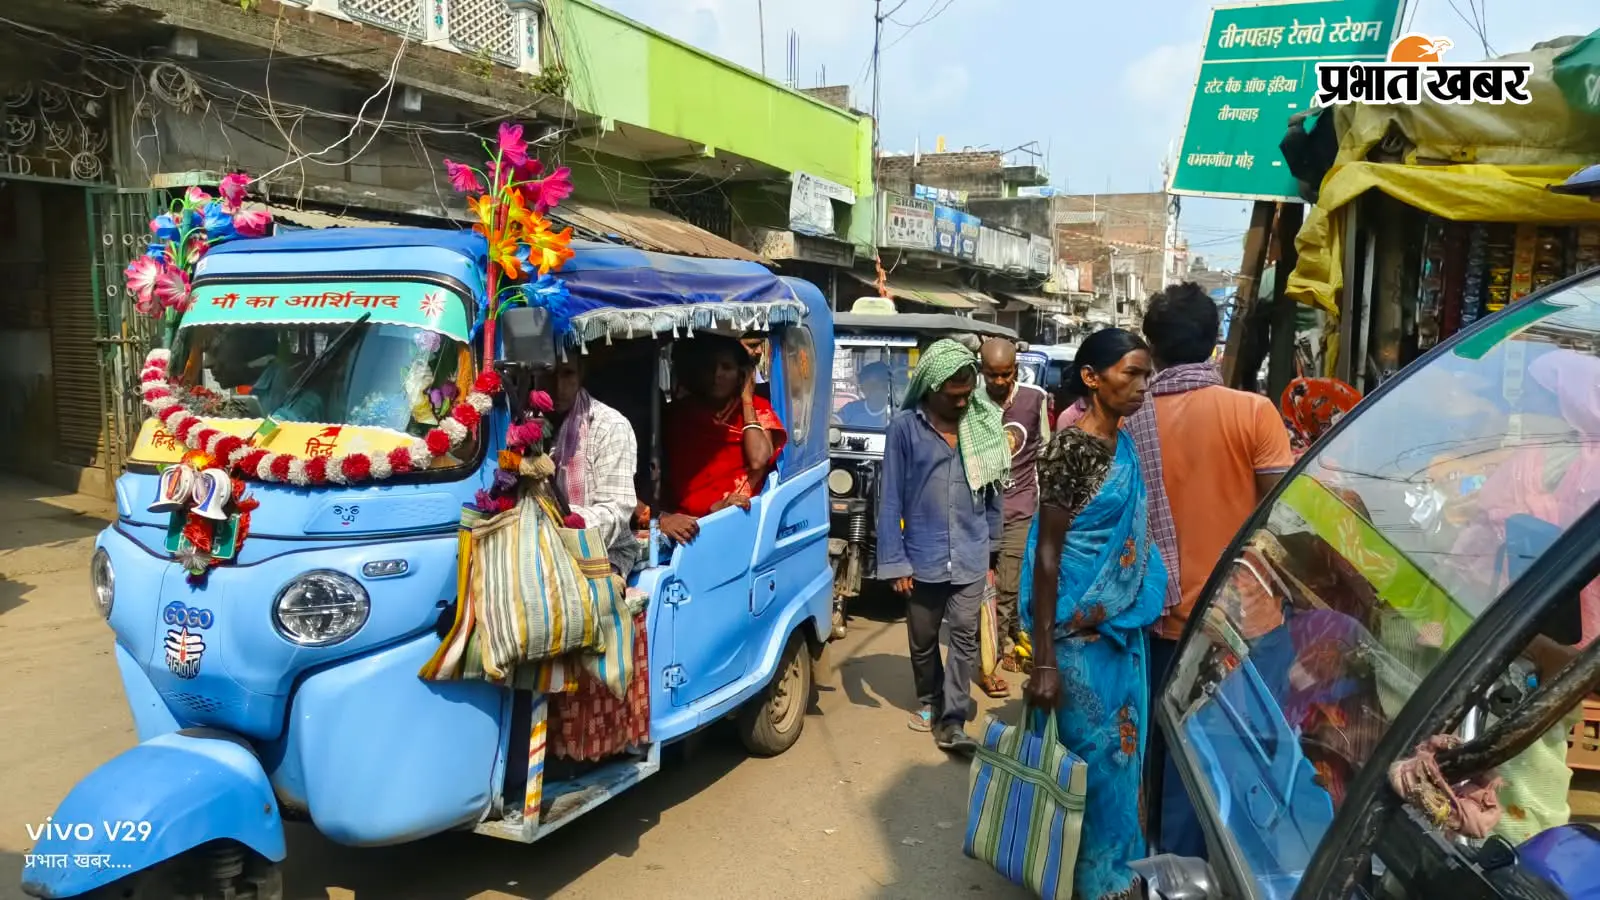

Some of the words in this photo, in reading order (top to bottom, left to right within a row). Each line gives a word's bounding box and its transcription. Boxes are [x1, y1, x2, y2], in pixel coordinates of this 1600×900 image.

[1218, 23, 1285, 49] तीनपहाड़
[1288, 18, 1325, 45] रेलवे
[1329, 16, 1383, 43] स्टेशन
[1204, 79, 1223, 94] स्टेट
[1243, 77, 1265, 93] ऑफ
[1267, 76, 1298, 96] इंडिया
[1217, 105, 1260, 123] तीनपहाड़
[1235, 151, 1255, 171] मोड़
[895, 197, 928, 210] SHAMA
[245, 295, 279, 309] का
[305, 437, 337, 457] हिन्द
[163, 603, 214, 629] GOGO
